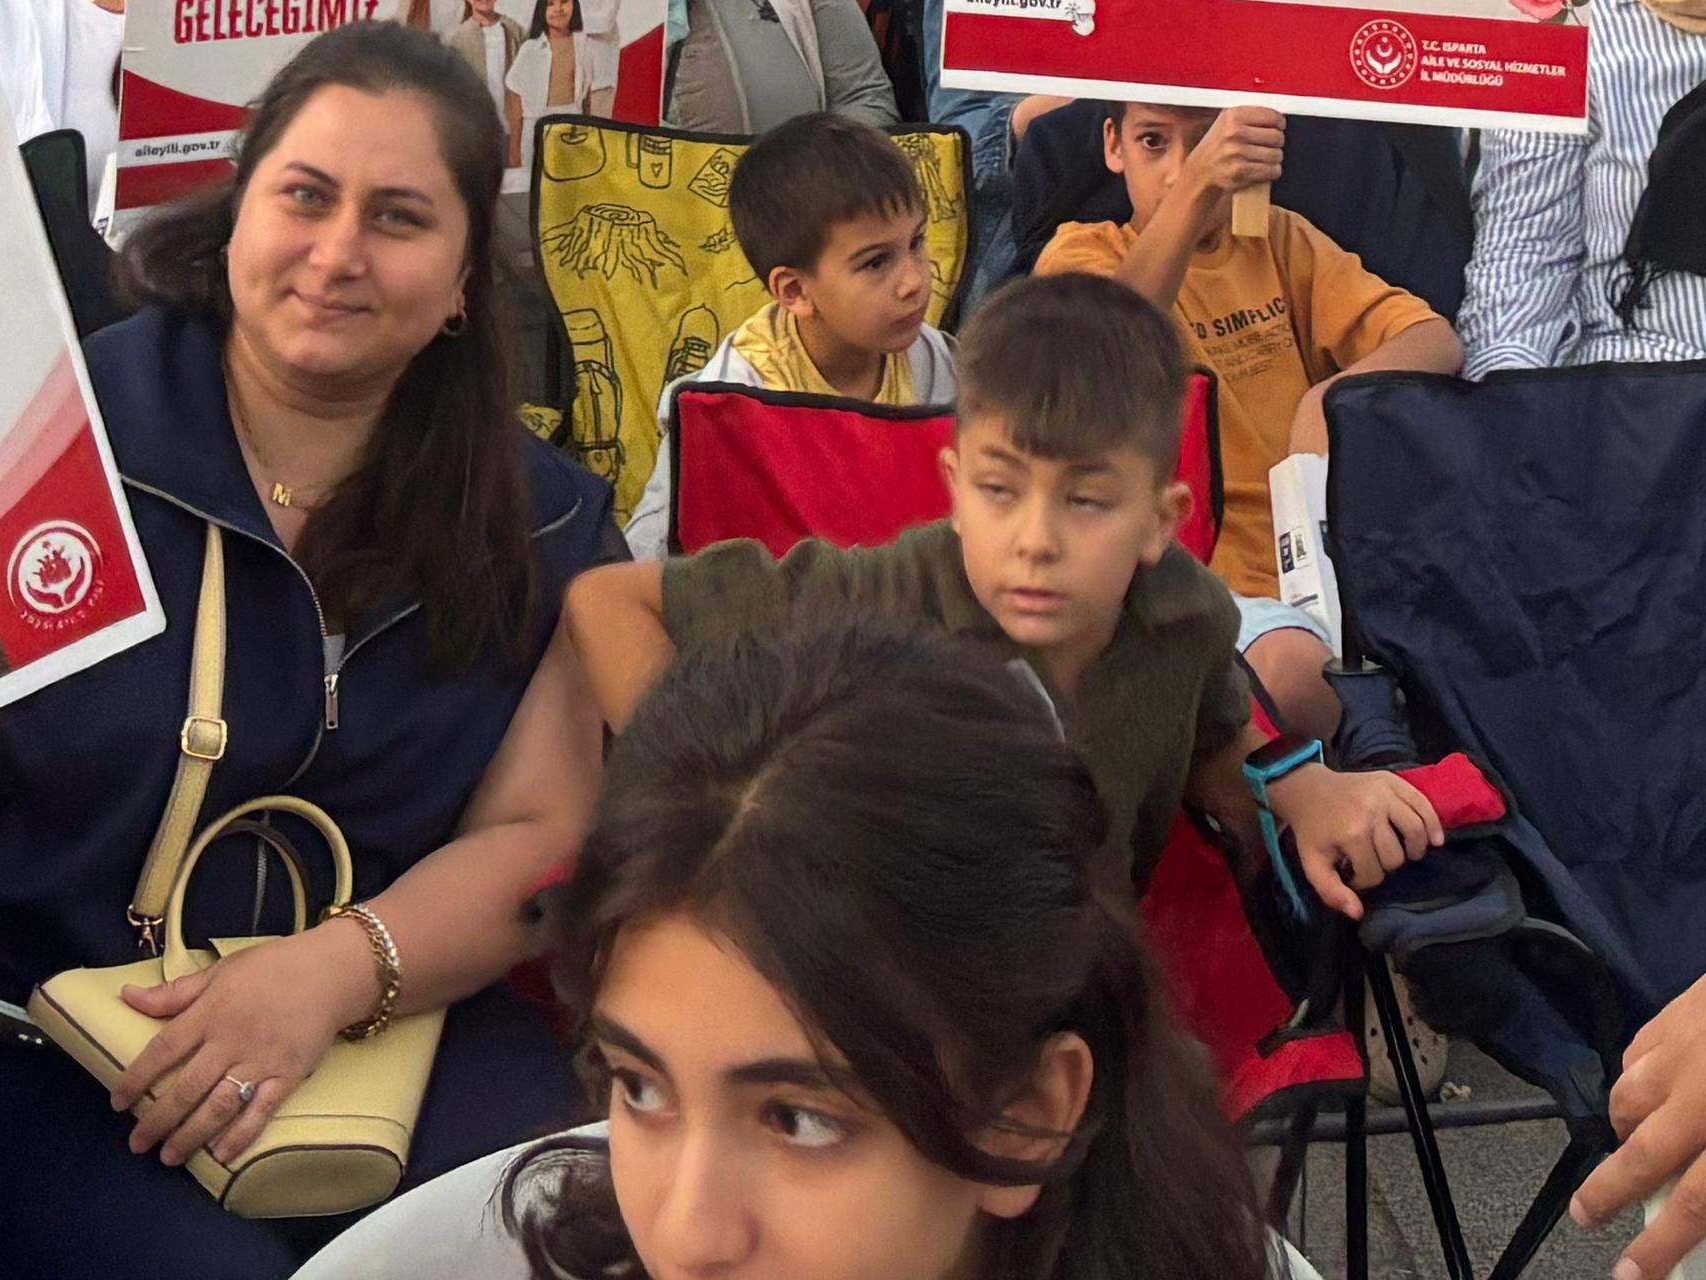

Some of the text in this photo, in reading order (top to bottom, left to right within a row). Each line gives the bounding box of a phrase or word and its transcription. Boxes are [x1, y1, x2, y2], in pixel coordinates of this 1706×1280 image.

[1421, 40, 1487, 55] T.C. ISPARTA
[1421, 56, 1566, 77] AİLE VE SOSYAL HİZMETLER
